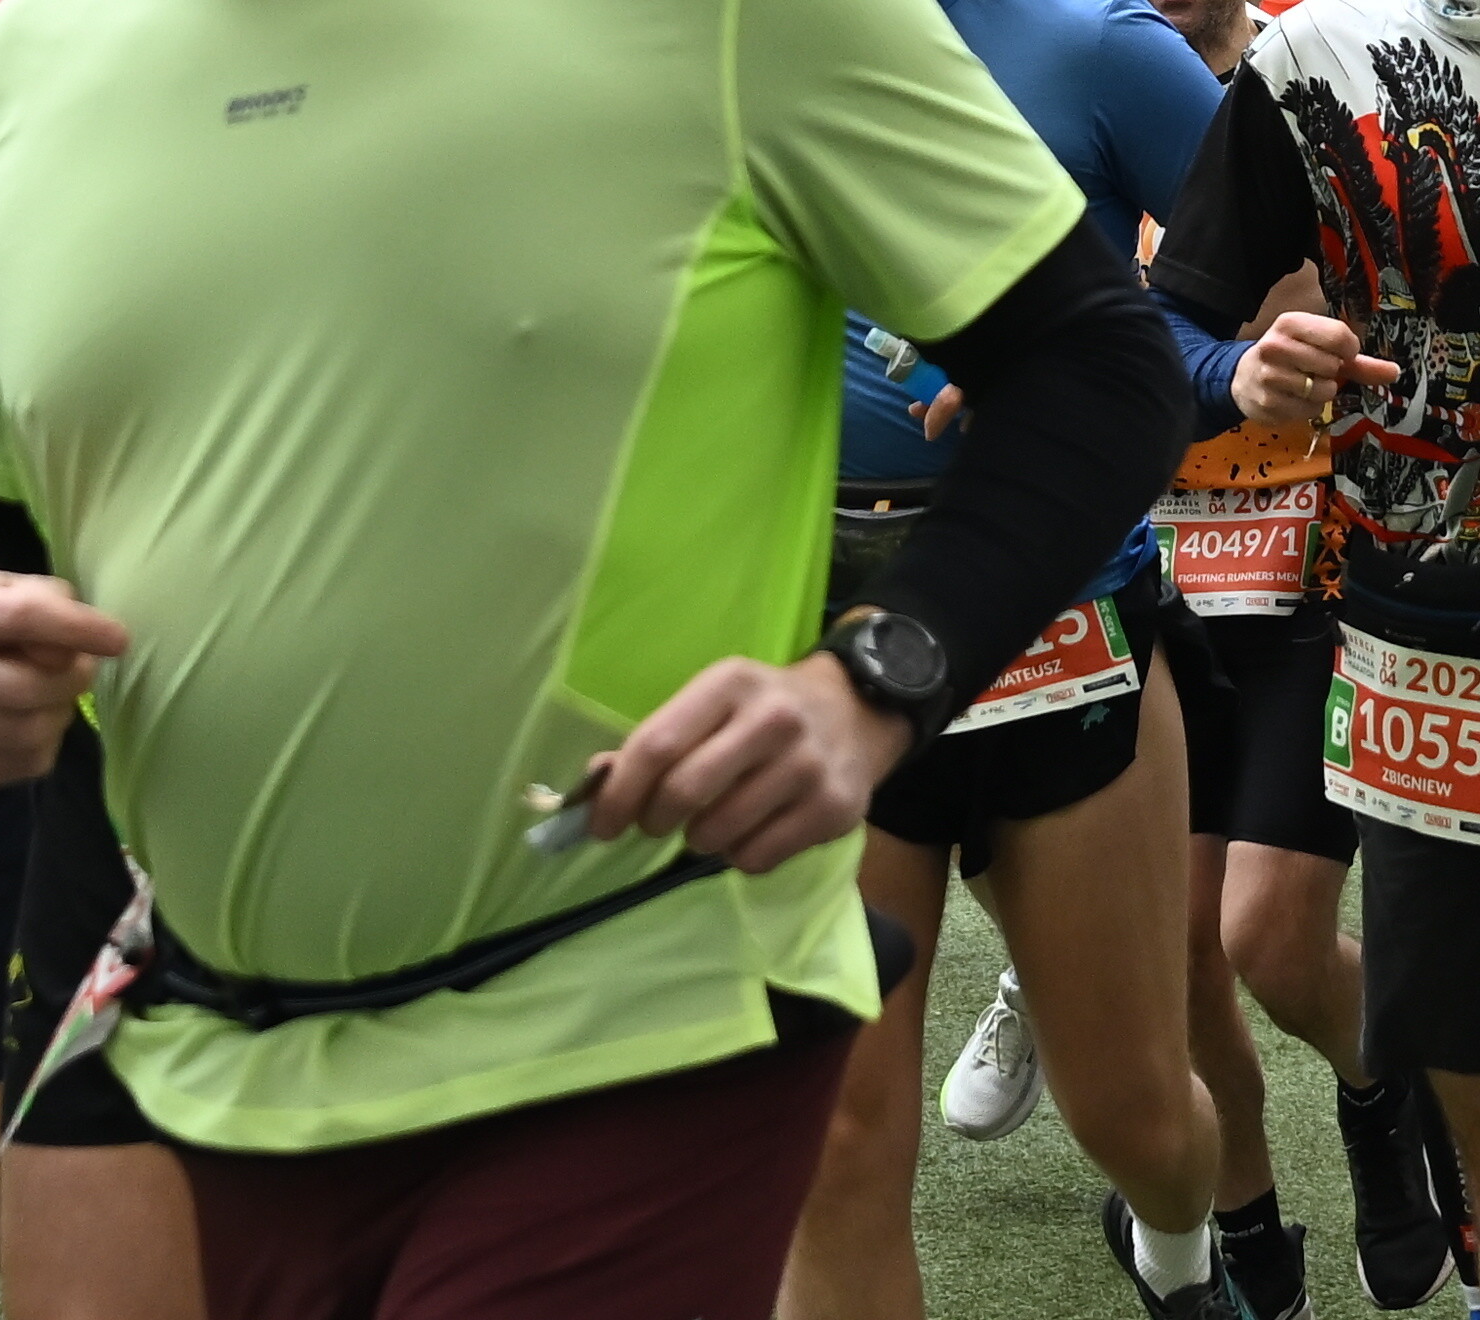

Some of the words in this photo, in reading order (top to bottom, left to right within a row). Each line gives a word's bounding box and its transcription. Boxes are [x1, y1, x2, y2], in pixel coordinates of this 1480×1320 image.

[1208, 502, 1227, 514] 04
[1179, 524, 1300, 559] 4049/1
[1178, 572, 1226, 584] FIGHTING
[1227, 571, 1275, 583] RUNNERS
[1276, 573, 1300, 582] MEN
[1380, 650, 1398, 669] 19
[990, 657, 1064, 691] MATEUSZ
[1379, 667, 1397, 688] 04
[1330, 705, 1350, 748] B
[1381, 766, 1453, 798] ZBIGNIEW
